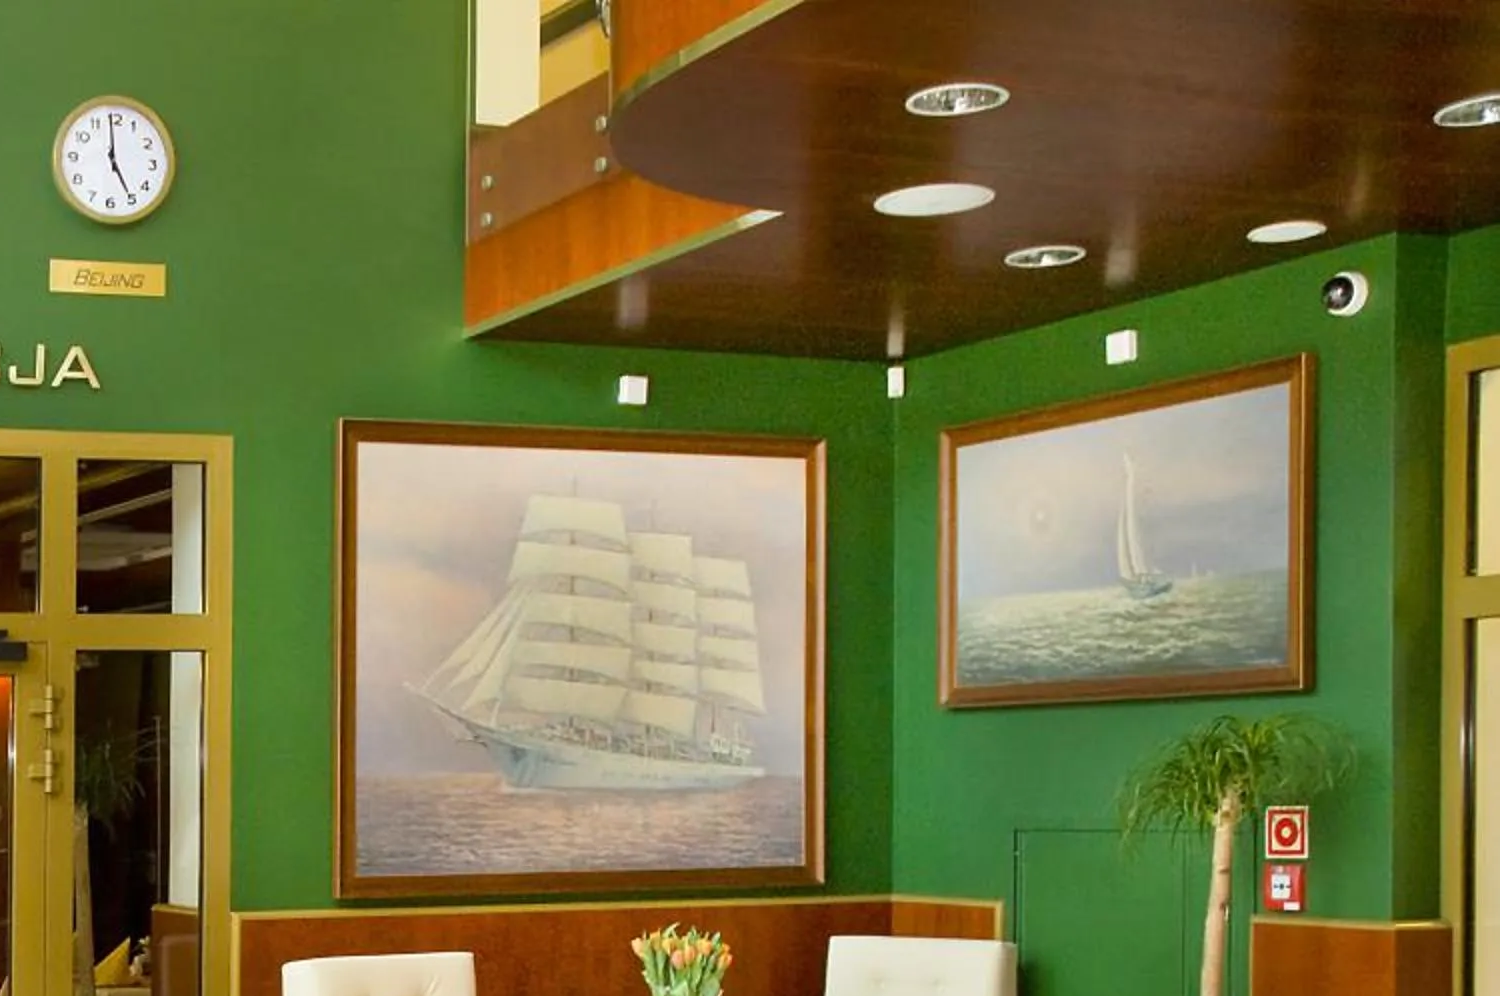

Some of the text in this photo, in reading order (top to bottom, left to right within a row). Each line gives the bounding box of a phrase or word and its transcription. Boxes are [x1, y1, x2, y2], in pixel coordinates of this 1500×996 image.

[91, 118, 100, 129] 11
[131, 121, 136, 132] 1
[76, 131, 90, 143] 10
[143, 138, 153, 149] 2
[68, 152, 79, 162] 9
[148, 160, 157, 171] 3
[73, 174, 82, 185] 8
[141, 180, 149, 191] 4
[88, 190, 97, 202] 7
[128, 194, 136, 205] 5
[105, 198, 115, 208] 6
